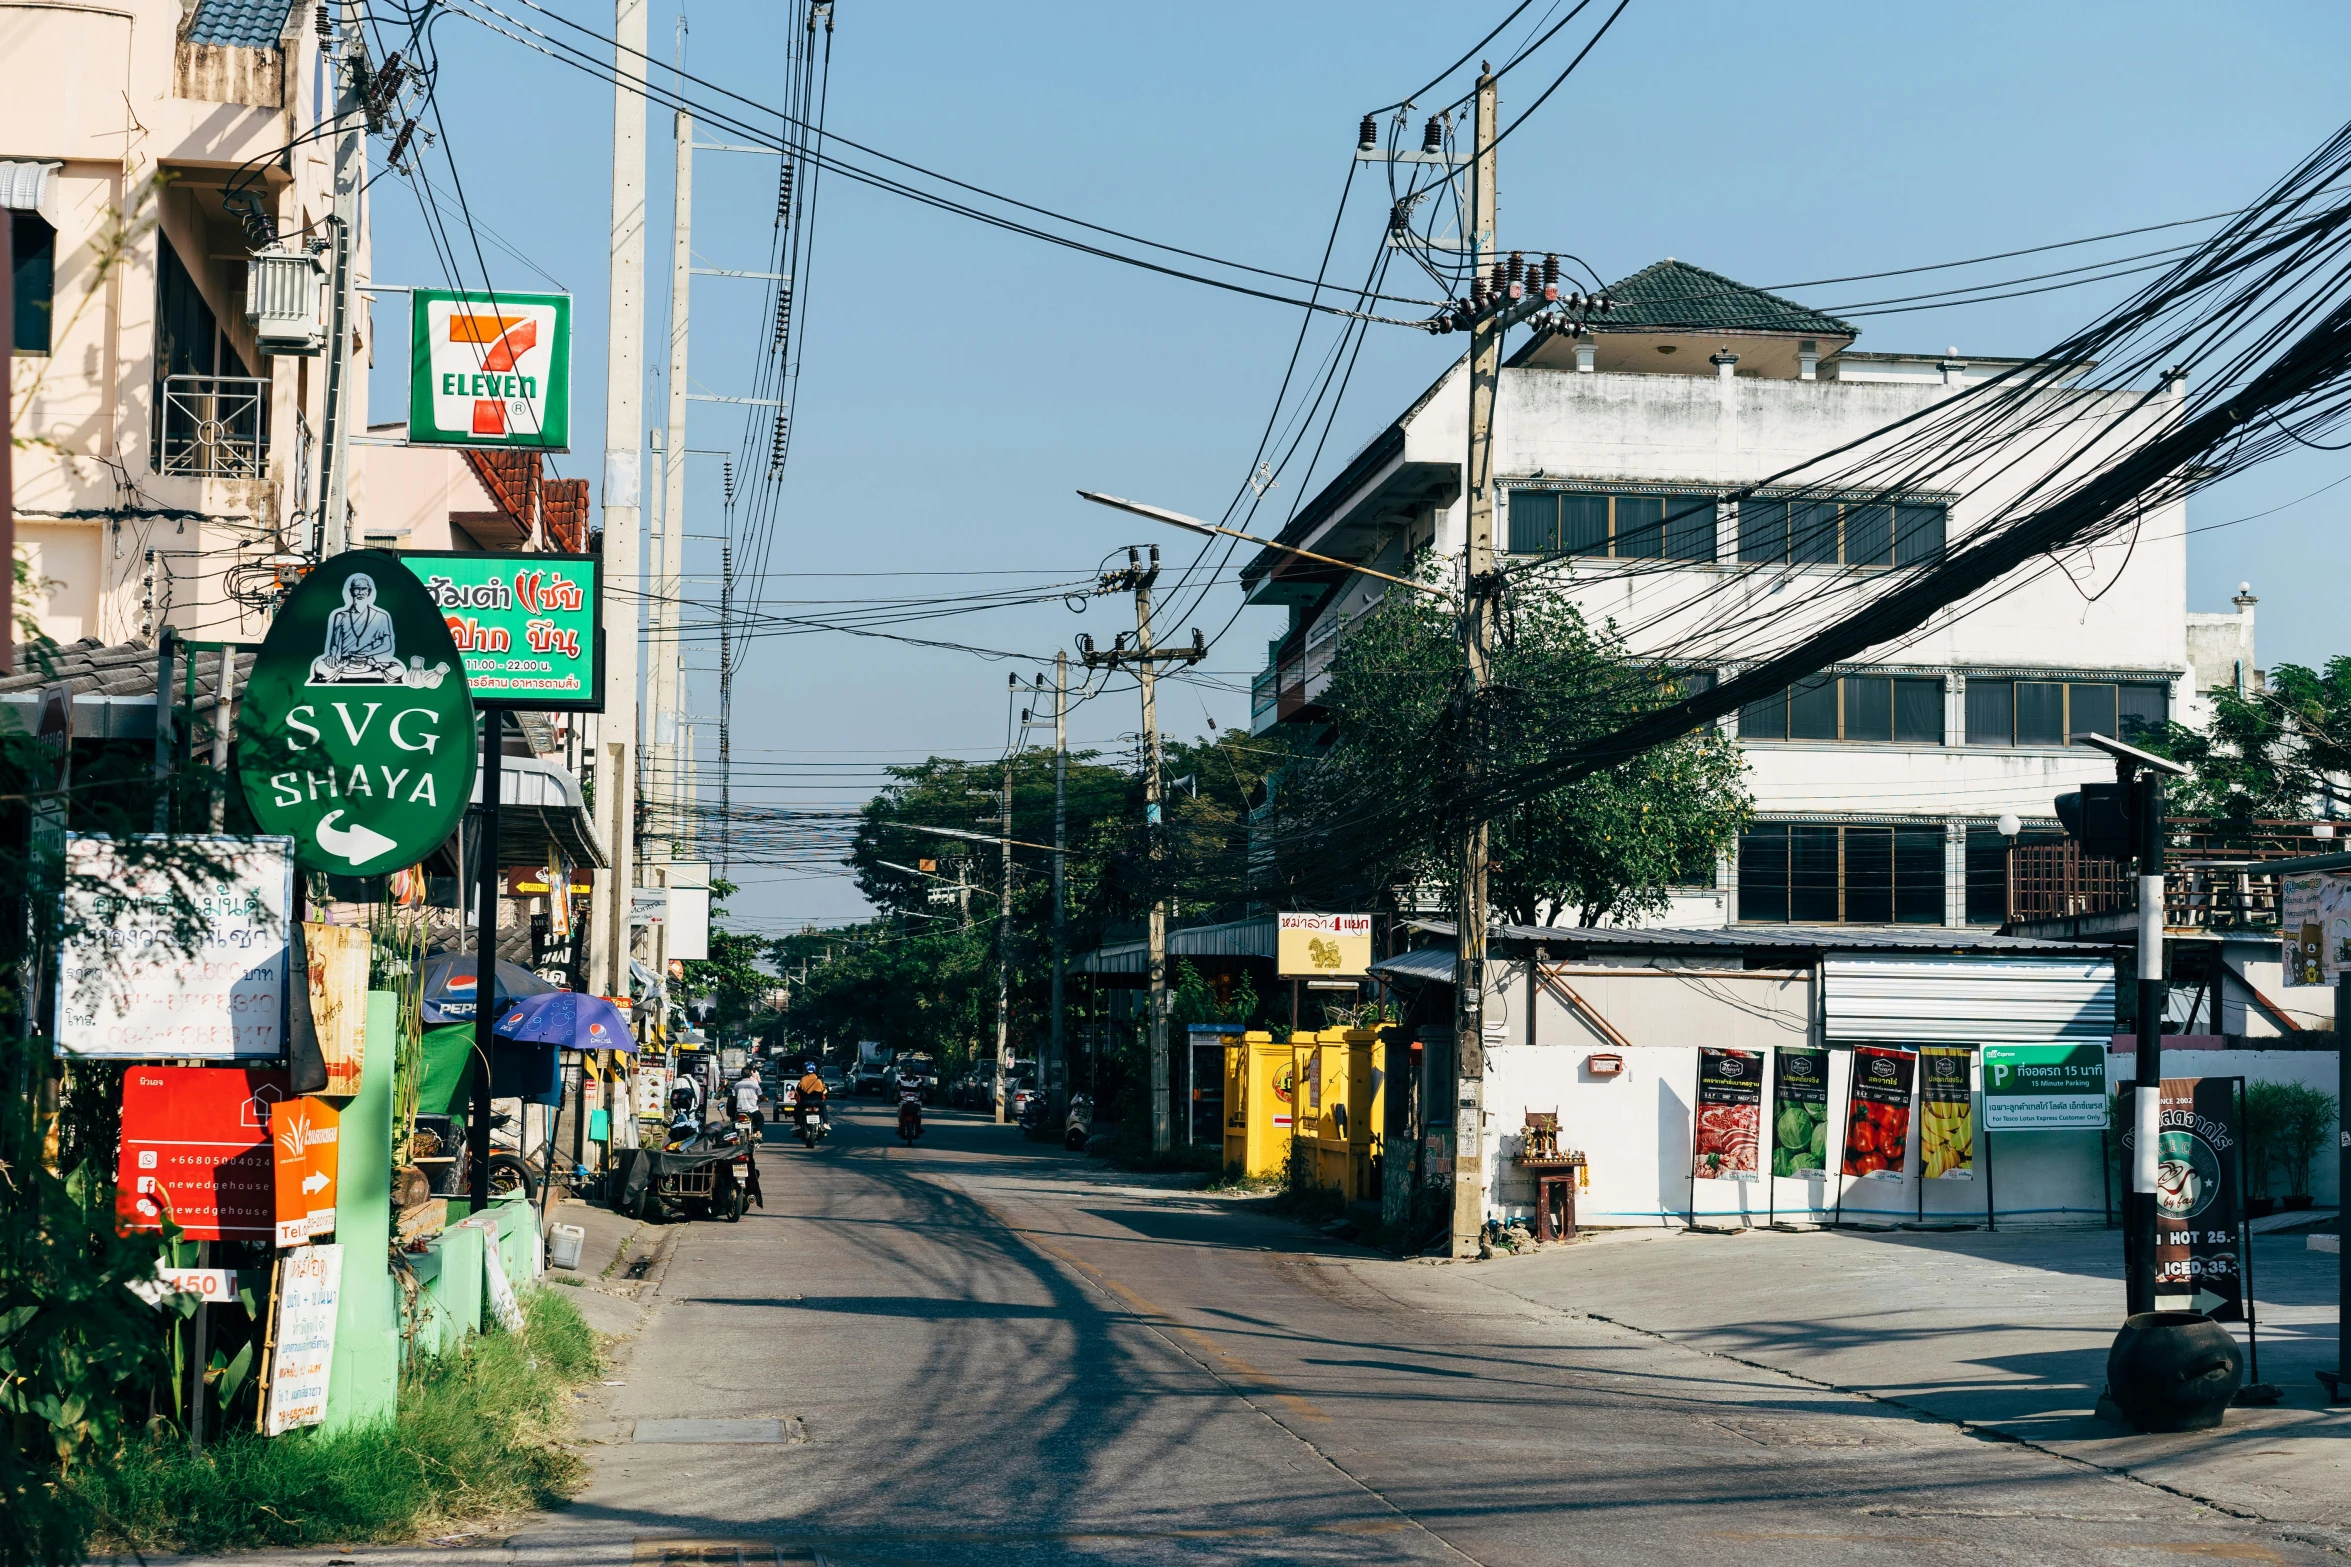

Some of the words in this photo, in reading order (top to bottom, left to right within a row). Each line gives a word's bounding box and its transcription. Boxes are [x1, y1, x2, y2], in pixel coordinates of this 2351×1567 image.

[450, 315, 537, 434] 7
[466, 660, 494, 670] 11.00
[508, 660, 537, 670] 22.00
[285, 702, 441, 756] SVG
[270, 763, 437, 808] SHAYA
[1329, 916, 1342, 931] 4
[1344, 919, 1369, 930] แยก
[243, 967, 274, 982] บาท
[439, 1003, 477, 1015] PEPS
[1993, 1063, 2009, 1087] P
[2016, 1061, 2061, 1077] ที่จอดรถ
[2064, 1066, 2078, 1076] 15
[2080, 1063, 2103, 1076] นาที
[2065, 1080, 2090, 1088] Parking
[2087, 1114, 2101, 1122] Only
[169, 1180, 270, 1192] newedgehouse
[2163, 1195, 2175, 1208] by
[2169, 1231, 2200, 1245] HOT
[2207, 1230, 2236, 1244] 25.-
[2164, 1261, 2202, 1275] ICED
